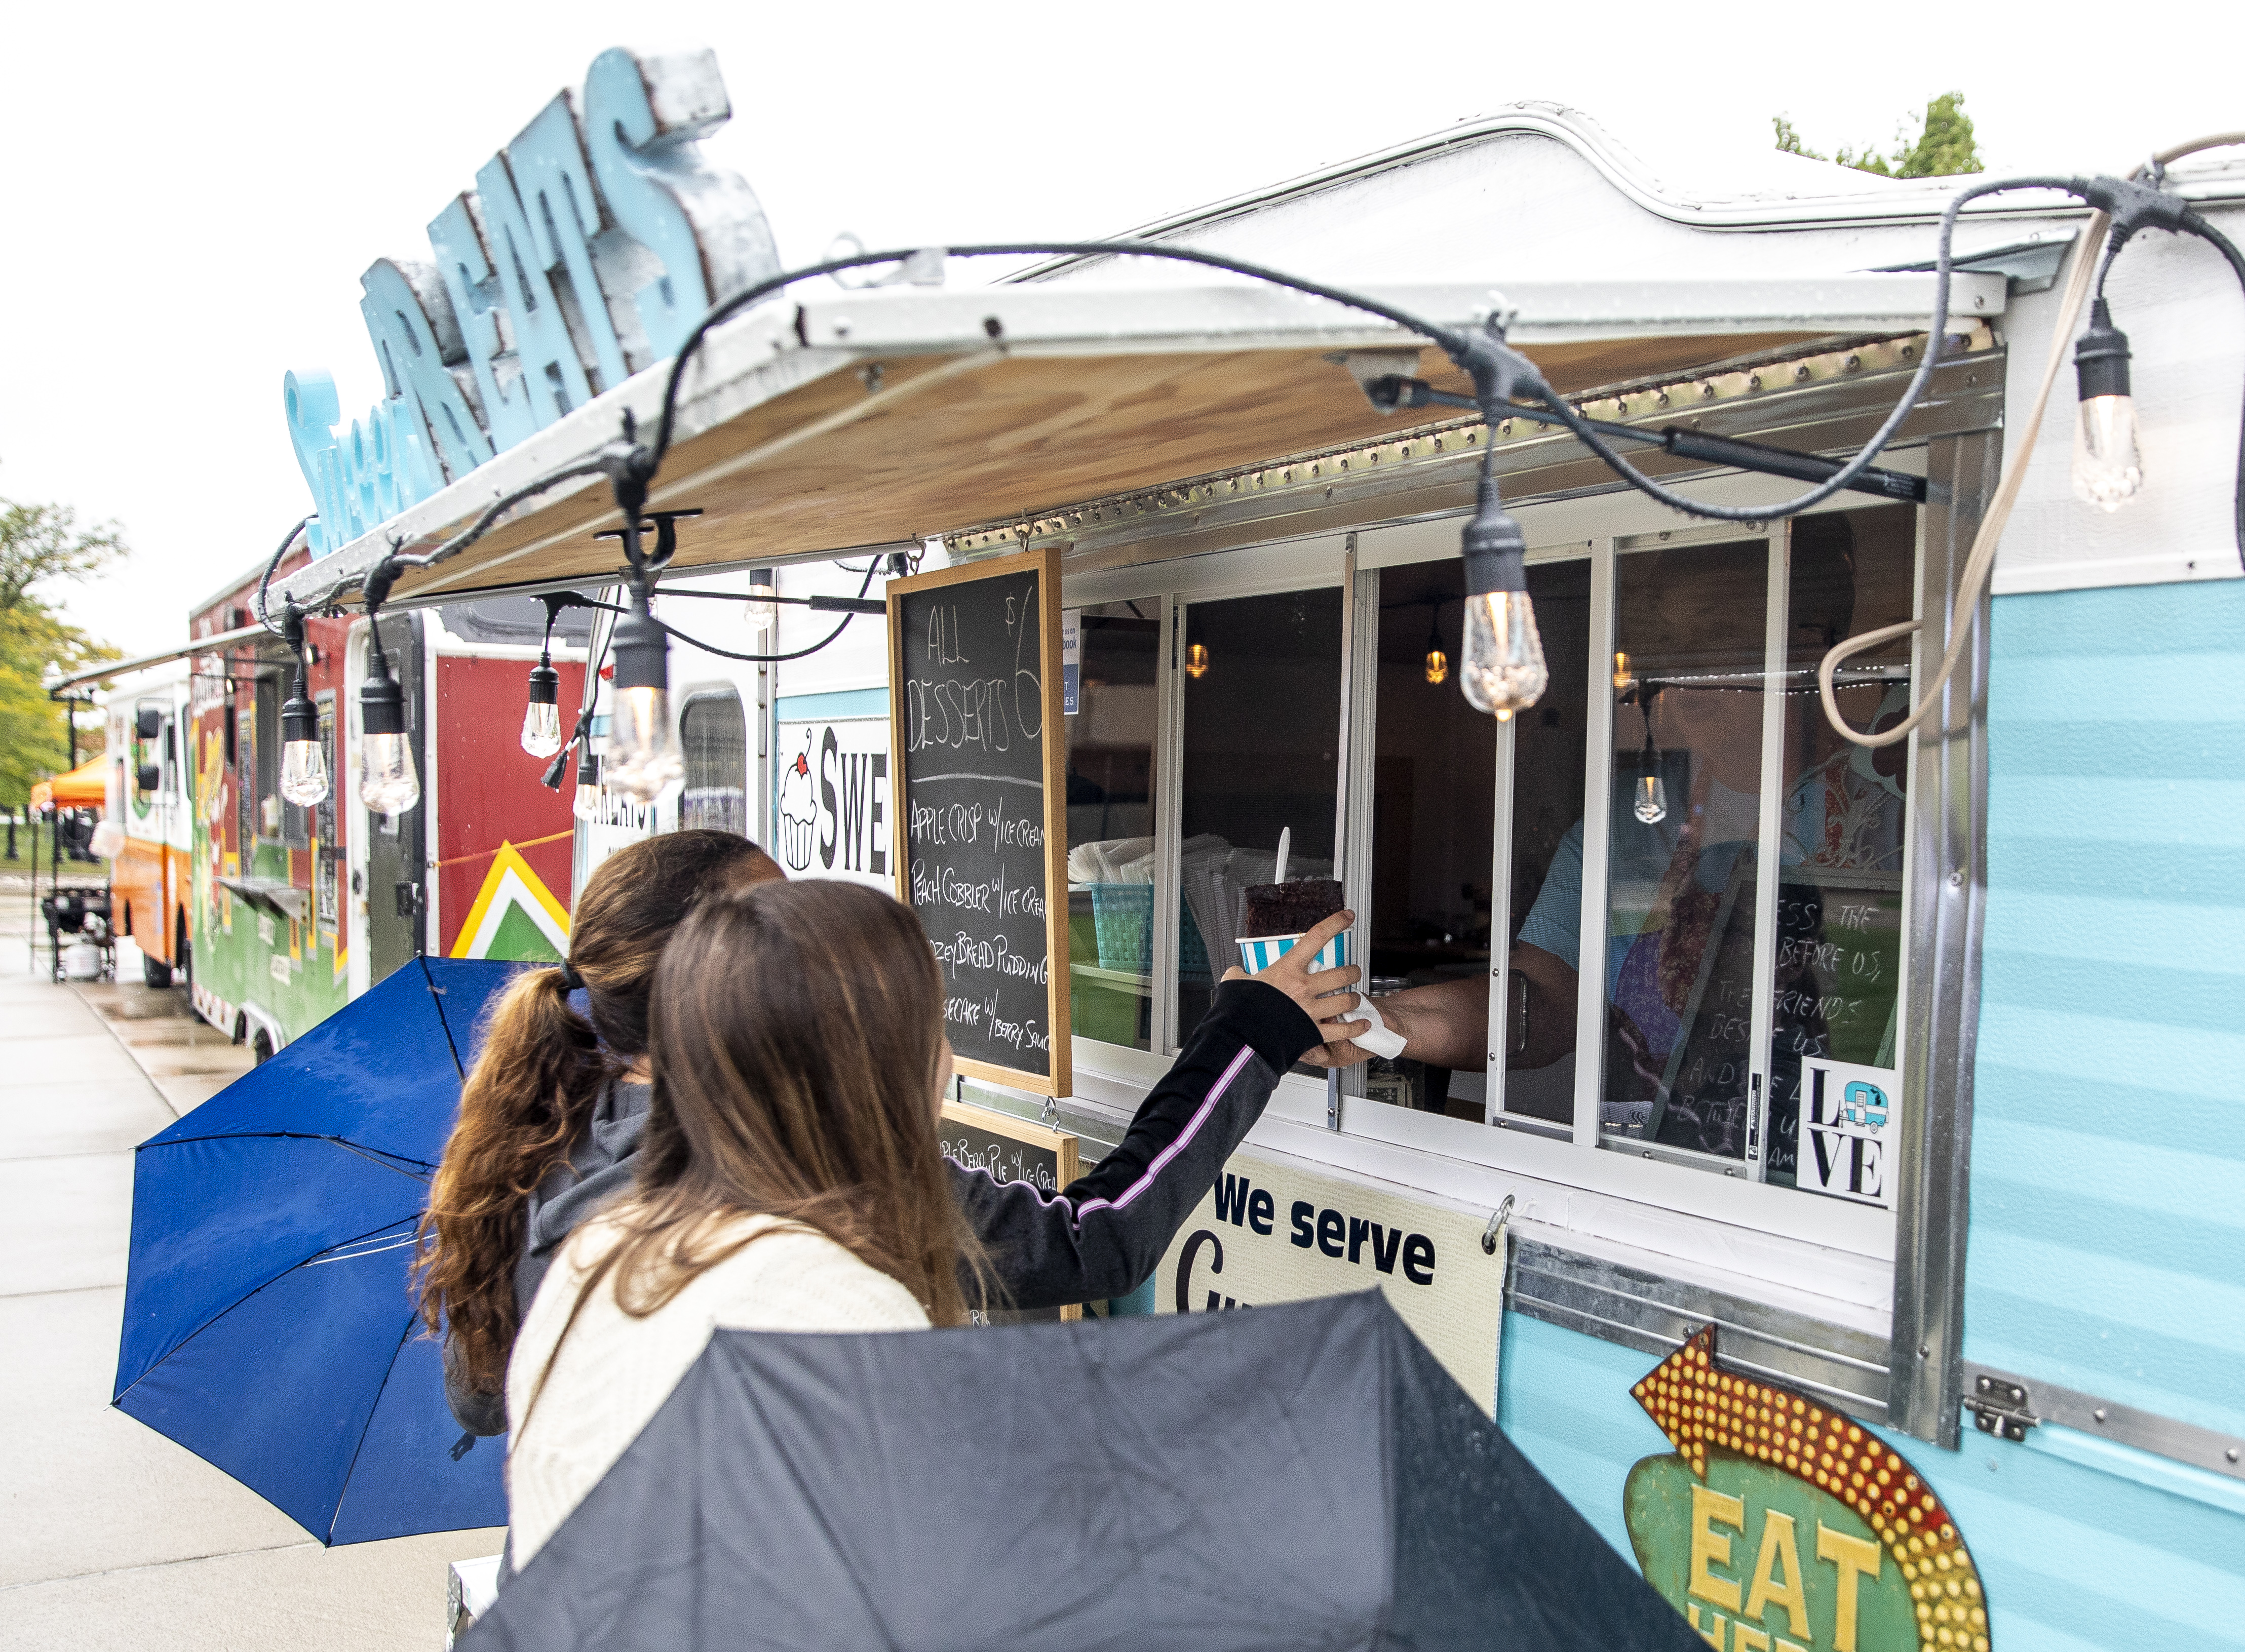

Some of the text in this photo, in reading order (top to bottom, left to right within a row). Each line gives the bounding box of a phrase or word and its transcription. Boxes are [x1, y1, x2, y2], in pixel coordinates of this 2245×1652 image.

[928, 605, 970, 667] ALL
[908, 678, 1010, 752] DESSERTS
[820, 726, 895, 882] SWE
[911, 798, 946, 845] APPLE
[948, 802, 982, 844] CRISP
[911, 858, 941, 906] PEACH
[942, 867, 991, 914] COBBLER
[1022, 886, 1047, 922] CREA
[955, 931, 994, 969] BREAD
[993, 934, 1048, 985] PUDDING
[1026, 1019, 1049, 1051] SAUC
[1036, 1163, 1056, 1191] CREA
[1290, 1200, 1436, 1286] serve
[1688, 1483, 1881, 1652] EAT
